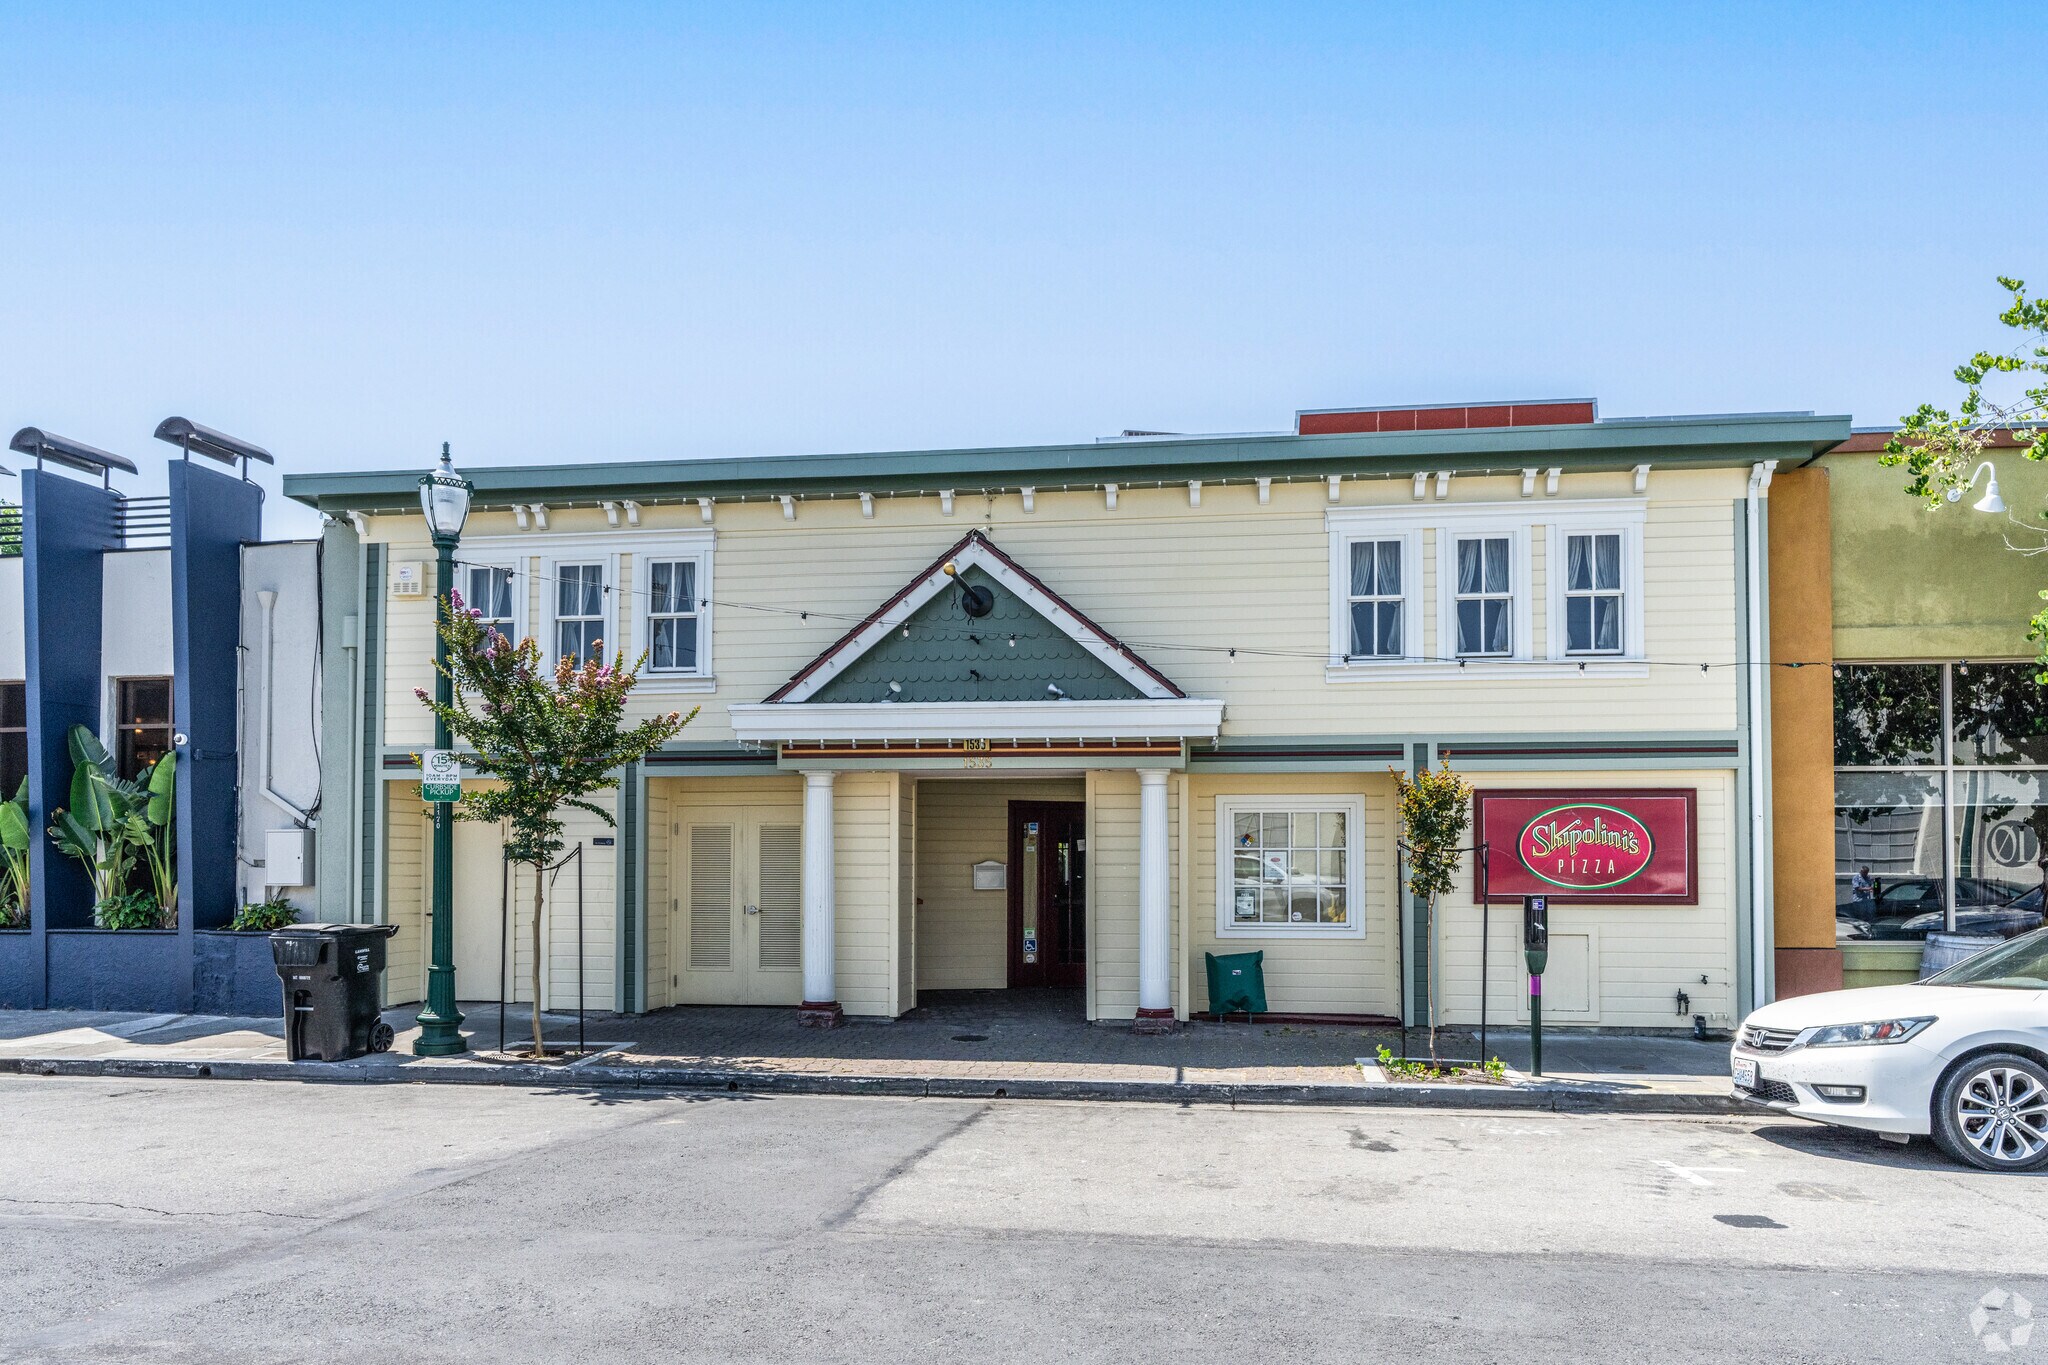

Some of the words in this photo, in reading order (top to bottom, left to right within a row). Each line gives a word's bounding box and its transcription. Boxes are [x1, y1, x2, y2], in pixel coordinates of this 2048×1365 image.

[436, 756, 448, 764] 15
[1532, 816, 1641, 857] Skipolini's
[1558, 859, 1615, 874] PIZZA
